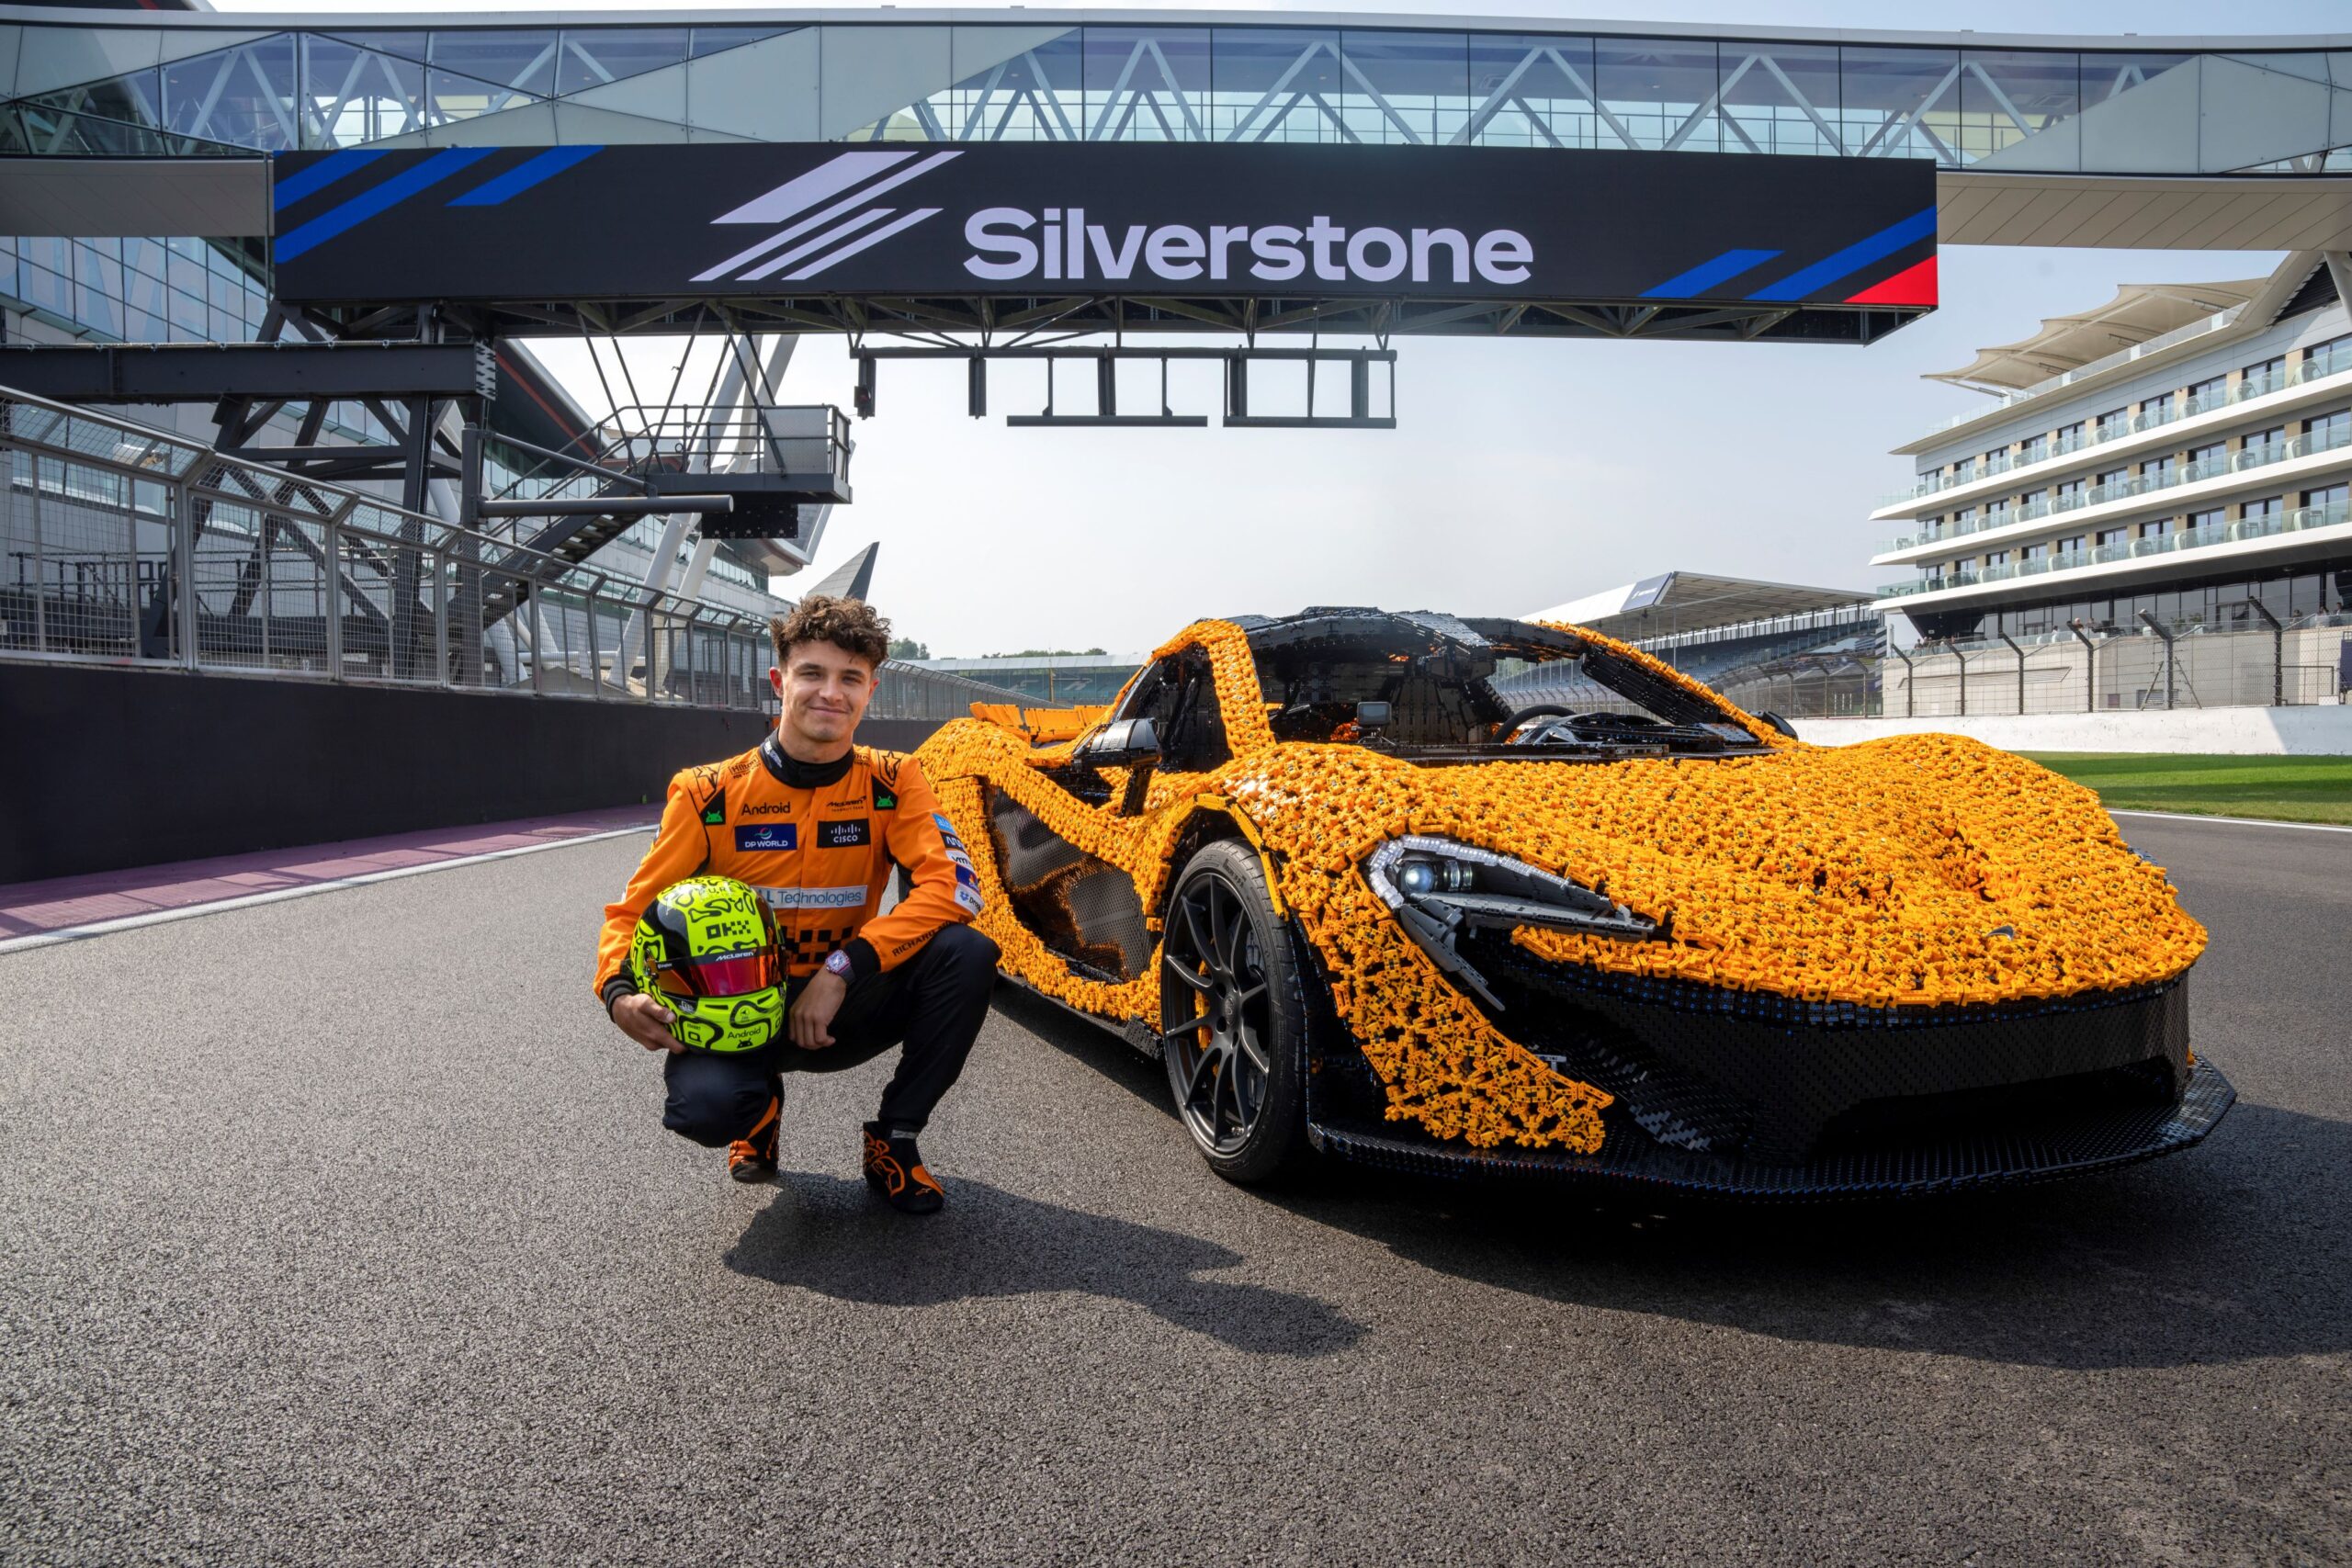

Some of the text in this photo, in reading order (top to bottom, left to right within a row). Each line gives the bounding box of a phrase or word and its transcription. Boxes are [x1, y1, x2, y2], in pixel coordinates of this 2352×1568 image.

[963, 207, 1534, 285] Silverstone
[741, 802, 791, 816] Android
[757, 840, 788, 848] WORLD
[832, 834, 859, 843] CISCO
[777, 889, 862, 907] Technologies
[891, 930, 936, 957] RICHARD
[716, 951, 755, 962] McLaren
[727, 1026, 762, 1040] Android
